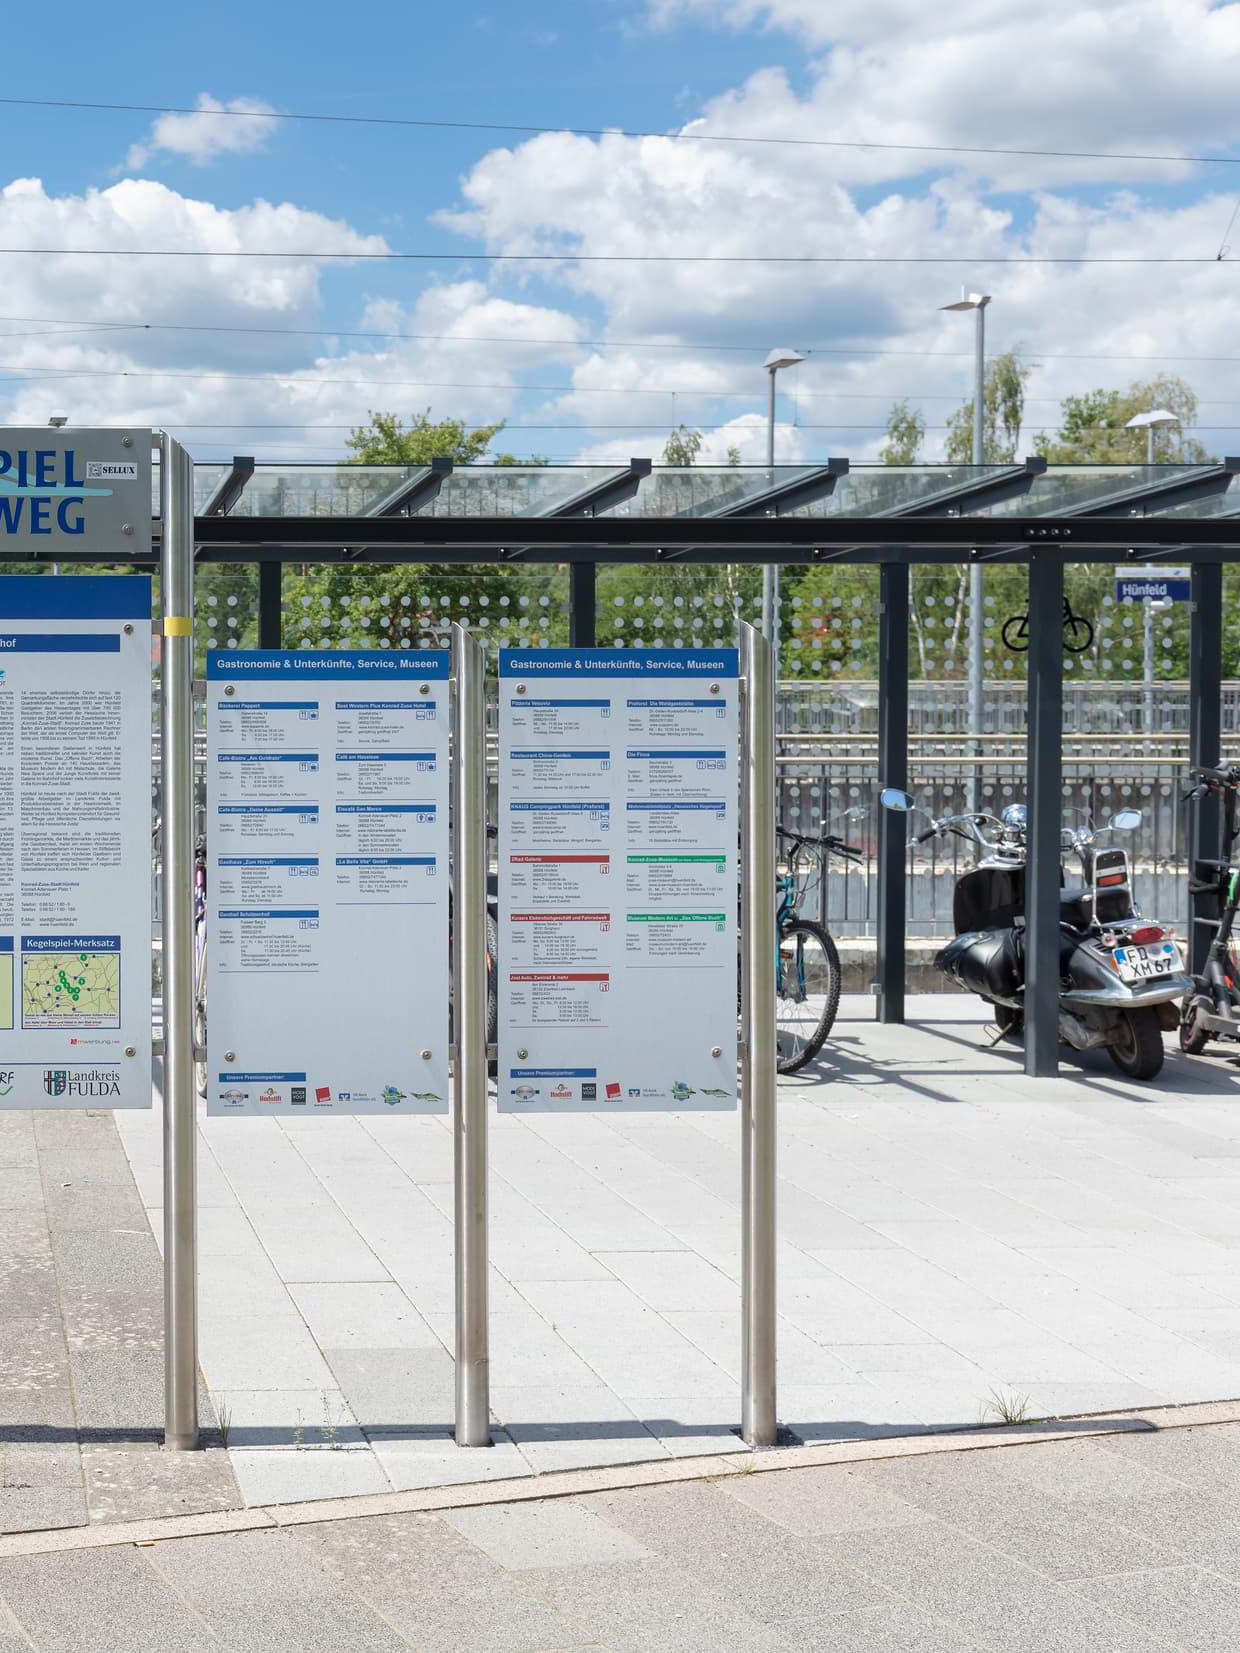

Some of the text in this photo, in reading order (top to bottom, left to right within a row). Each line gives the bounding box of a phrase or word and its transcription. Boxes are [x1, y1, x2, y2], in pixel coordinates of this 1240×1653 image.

[102, 466, 135, 474] SELLUX
[1122, 583, 1168, 596] Hünfeld
[217, 659, 438, 670] Gastronomie & Unterkünfte, Service, Museen
[510, 660, 724, 670] Gastronomie & Unterkünfte, Service, Museen
[27, 938, 115, 950] Kegelspiel-Merksatz
[1126, 947, 1148, 963] FD
[1131, 958, 1172, 978] XM 67
[68, 1070, 120, 1082] Landkreis
[68, 1082, 121, 1096] FULDA
